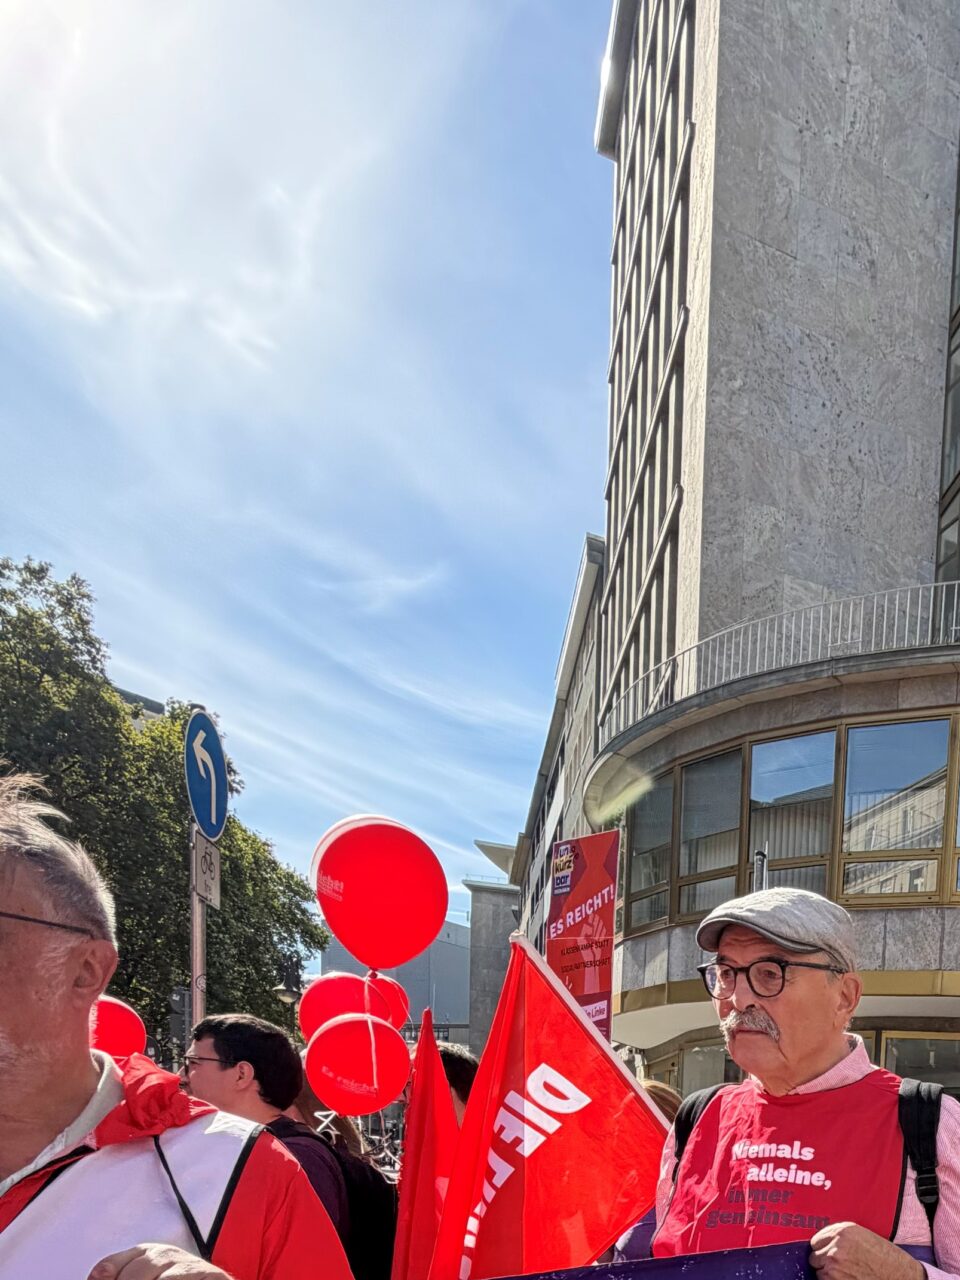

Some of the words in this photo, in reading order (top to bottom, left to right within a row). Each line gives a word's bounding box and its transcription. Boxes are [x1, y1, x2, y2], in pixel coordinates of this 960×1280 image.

[550, 918, 564, 940] ES
[566, 884, 615, 928] REICHT!
[493, 1062, 593, 1158] DIE
[731, 1140, 815, 1161] Niemals
[746, 1163, 832, 1191] alleine,
